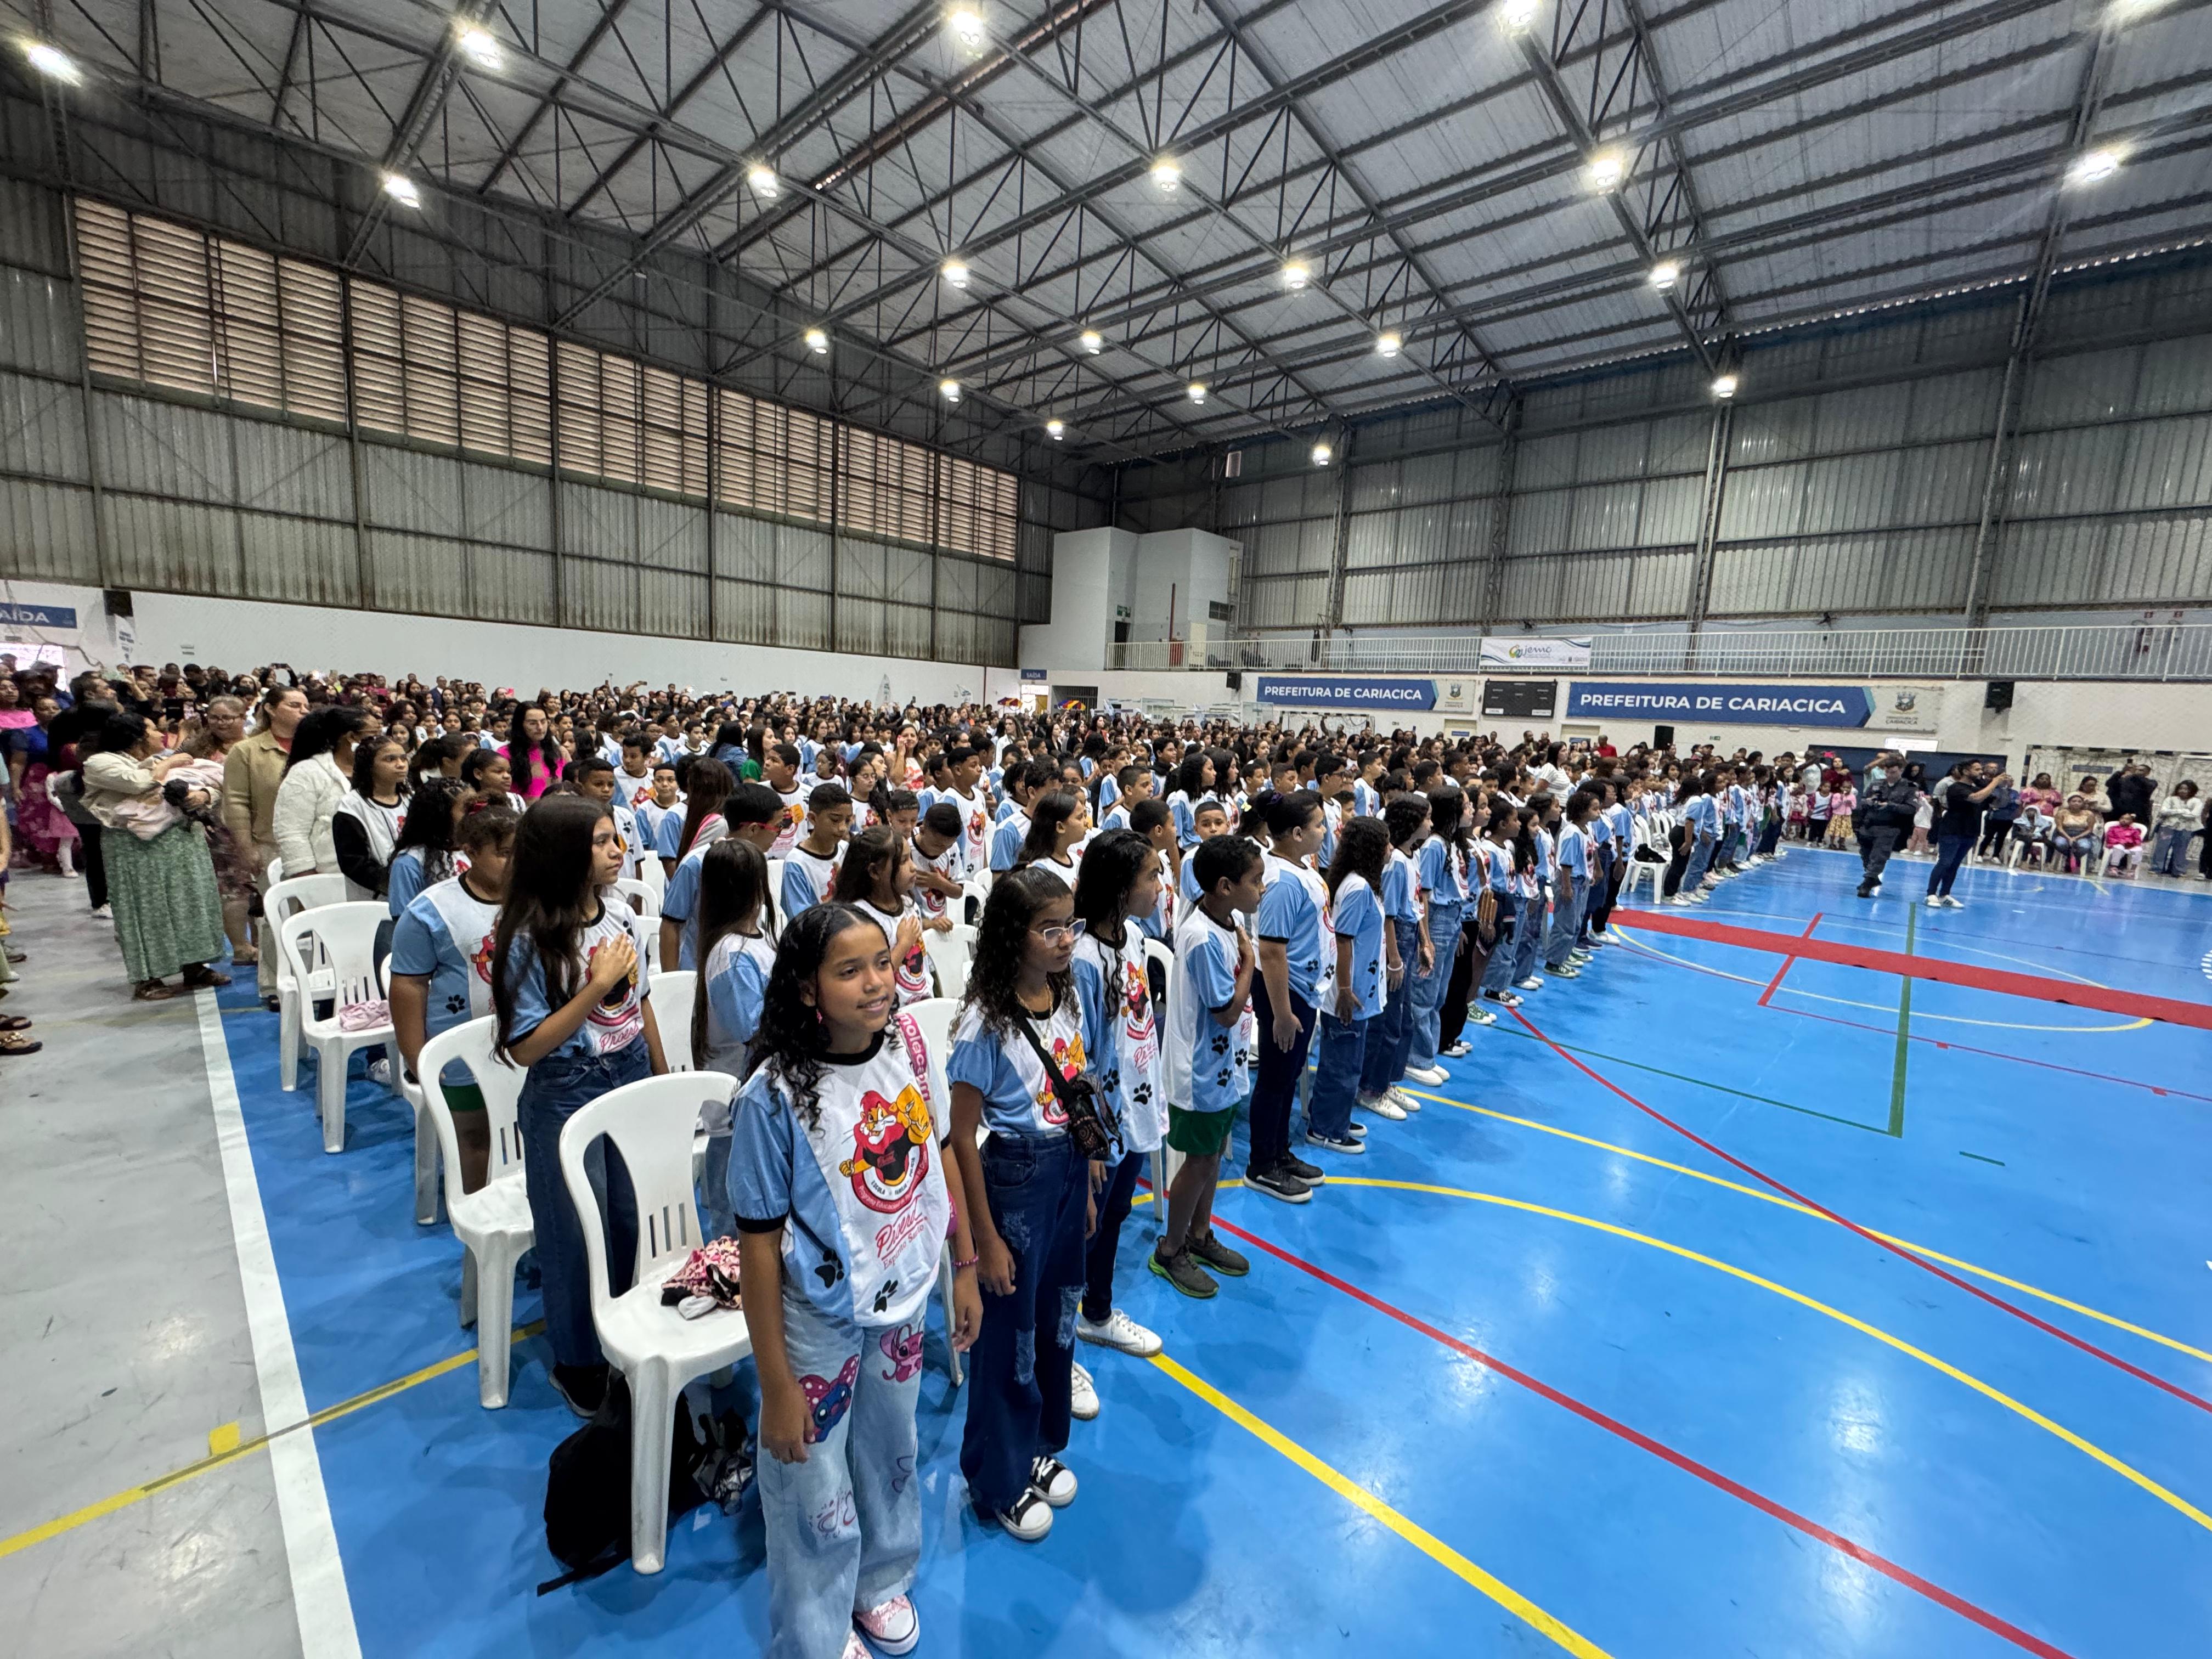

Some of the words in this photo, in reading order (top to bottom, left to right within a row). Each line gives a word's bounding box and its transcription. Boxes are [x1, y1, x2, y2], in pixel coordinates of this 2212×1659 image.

[1265, 686, 1331, 697] PREFEITURA
[1334, 688, 1351, 698] DE
[1353, 689, 1422, 700] CARIACICA
[1581, 694, 1690, 709] PREFEITURA
[1696, 697, 1723, 710] DE
[1728, 697, 1846, 713] CARIACICA
